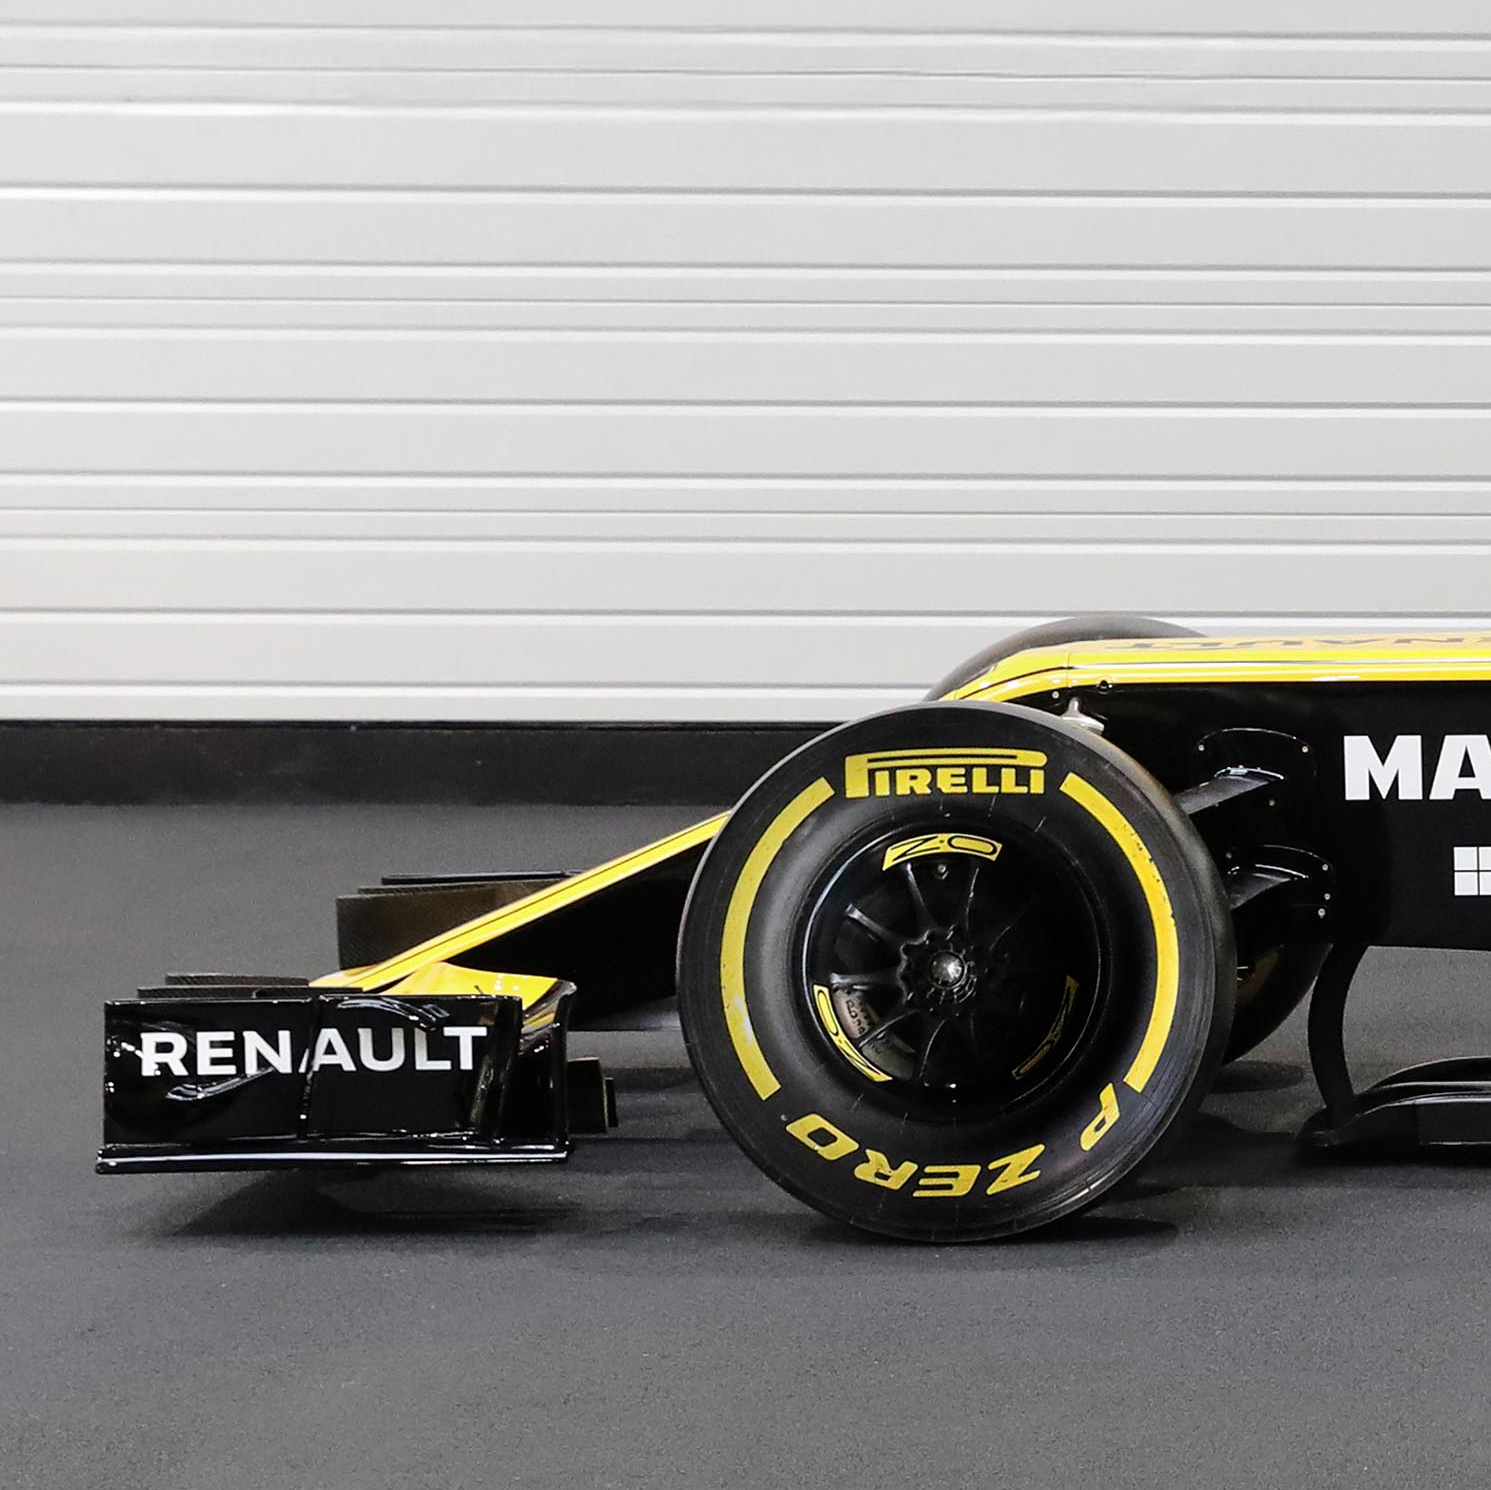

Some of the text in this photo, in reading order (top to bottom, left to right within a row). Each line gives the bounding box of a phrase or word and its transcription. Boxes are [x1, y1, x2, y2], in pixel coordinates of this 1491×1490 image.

[844, 747, 1048, 799] PIRELLI
[140, 1025, 489, 1076] RENAULT
[785, 1083, 1119, 1198] P ZERO
